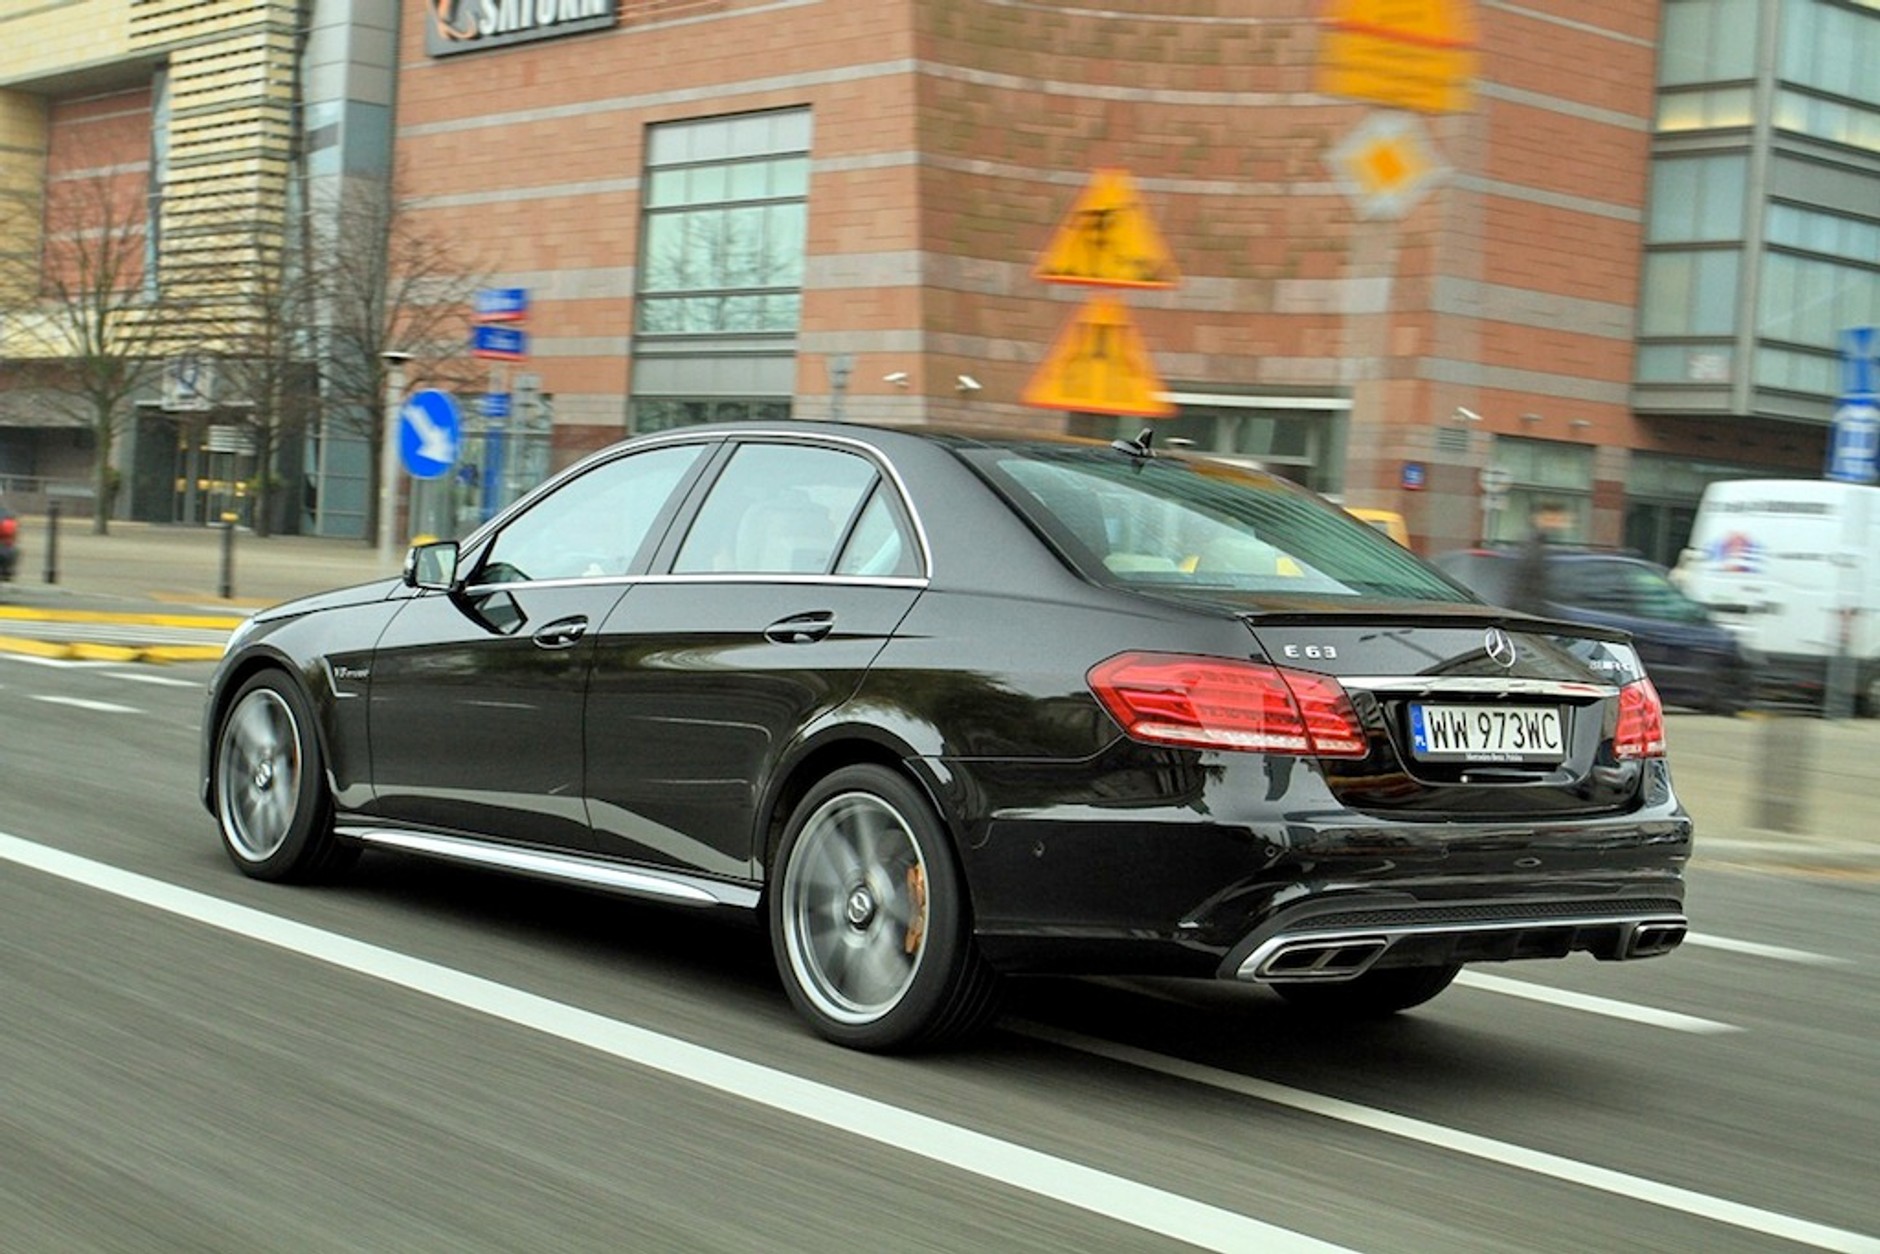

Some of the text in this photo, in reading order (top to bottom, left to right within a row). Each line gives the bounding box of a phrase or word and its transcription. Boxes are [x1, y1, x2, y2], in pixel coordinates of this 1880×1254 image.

[1284, 644, 1338, 659] E 63
[1428, 711, 1558, 749] WW 973WC
